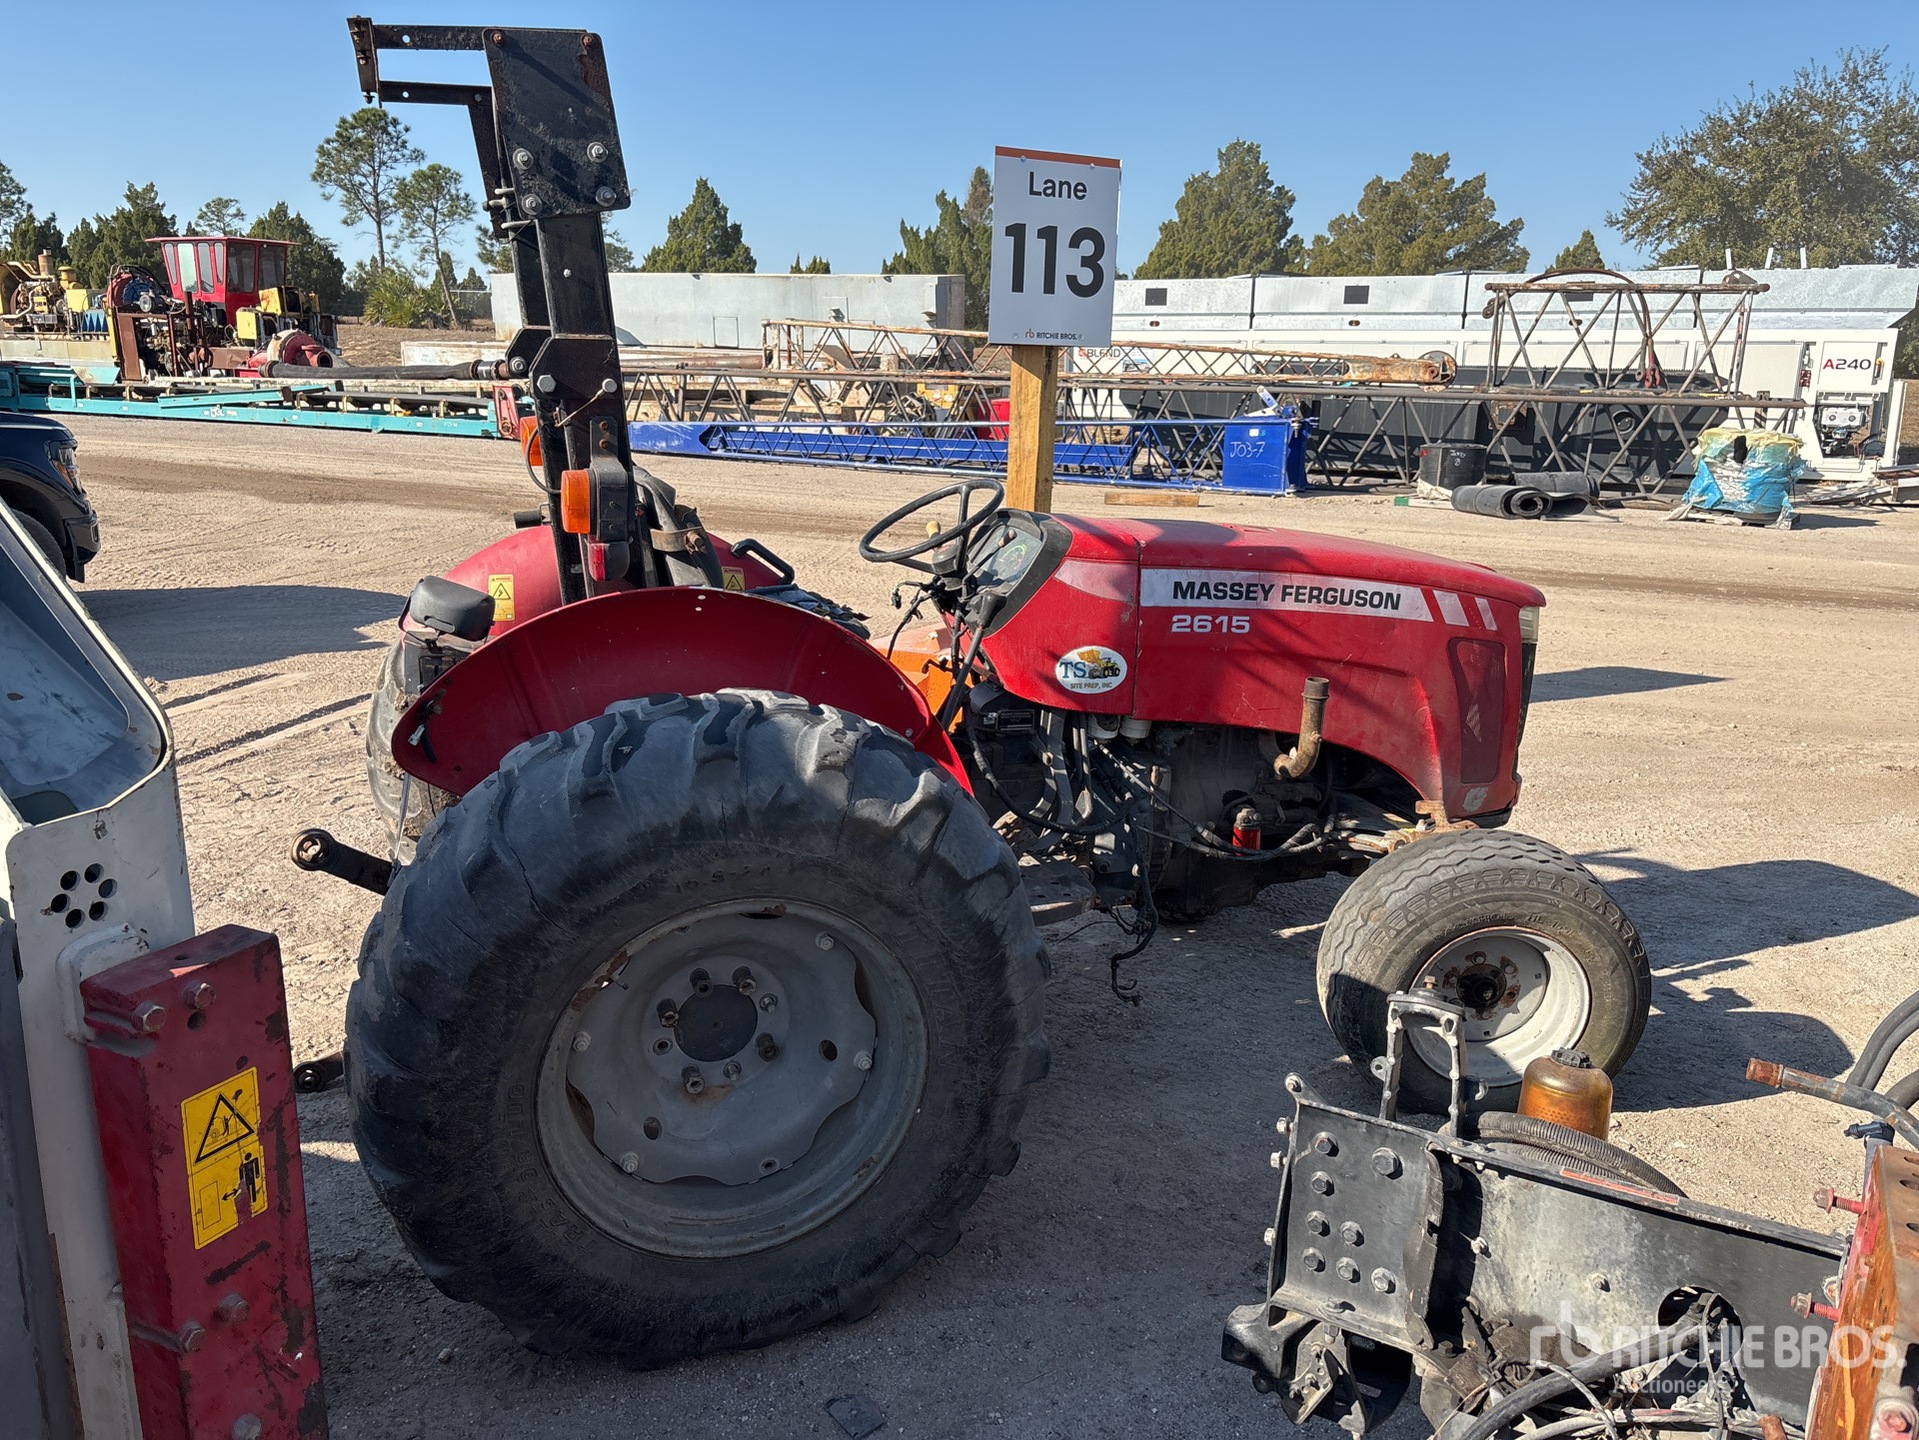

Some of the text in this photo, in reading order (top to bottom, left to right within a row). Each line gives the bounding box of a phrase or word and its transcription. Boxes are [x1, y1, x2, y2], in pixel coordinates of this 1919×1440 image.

[1029, 171, 1088, 201] Lane
[1005, 222, 1106, 298] 113
[1036, 332, 1060, 340] RITCHIE
[1822, 358, 1872, 370] A240
[1172, 580, 1401, 610] MASSEY FERGUSON
[1171, 614, 1250, 634] 2615
[1059, 661, 1087, 679] TS
[1070, 682, 1083, 690] SITE
